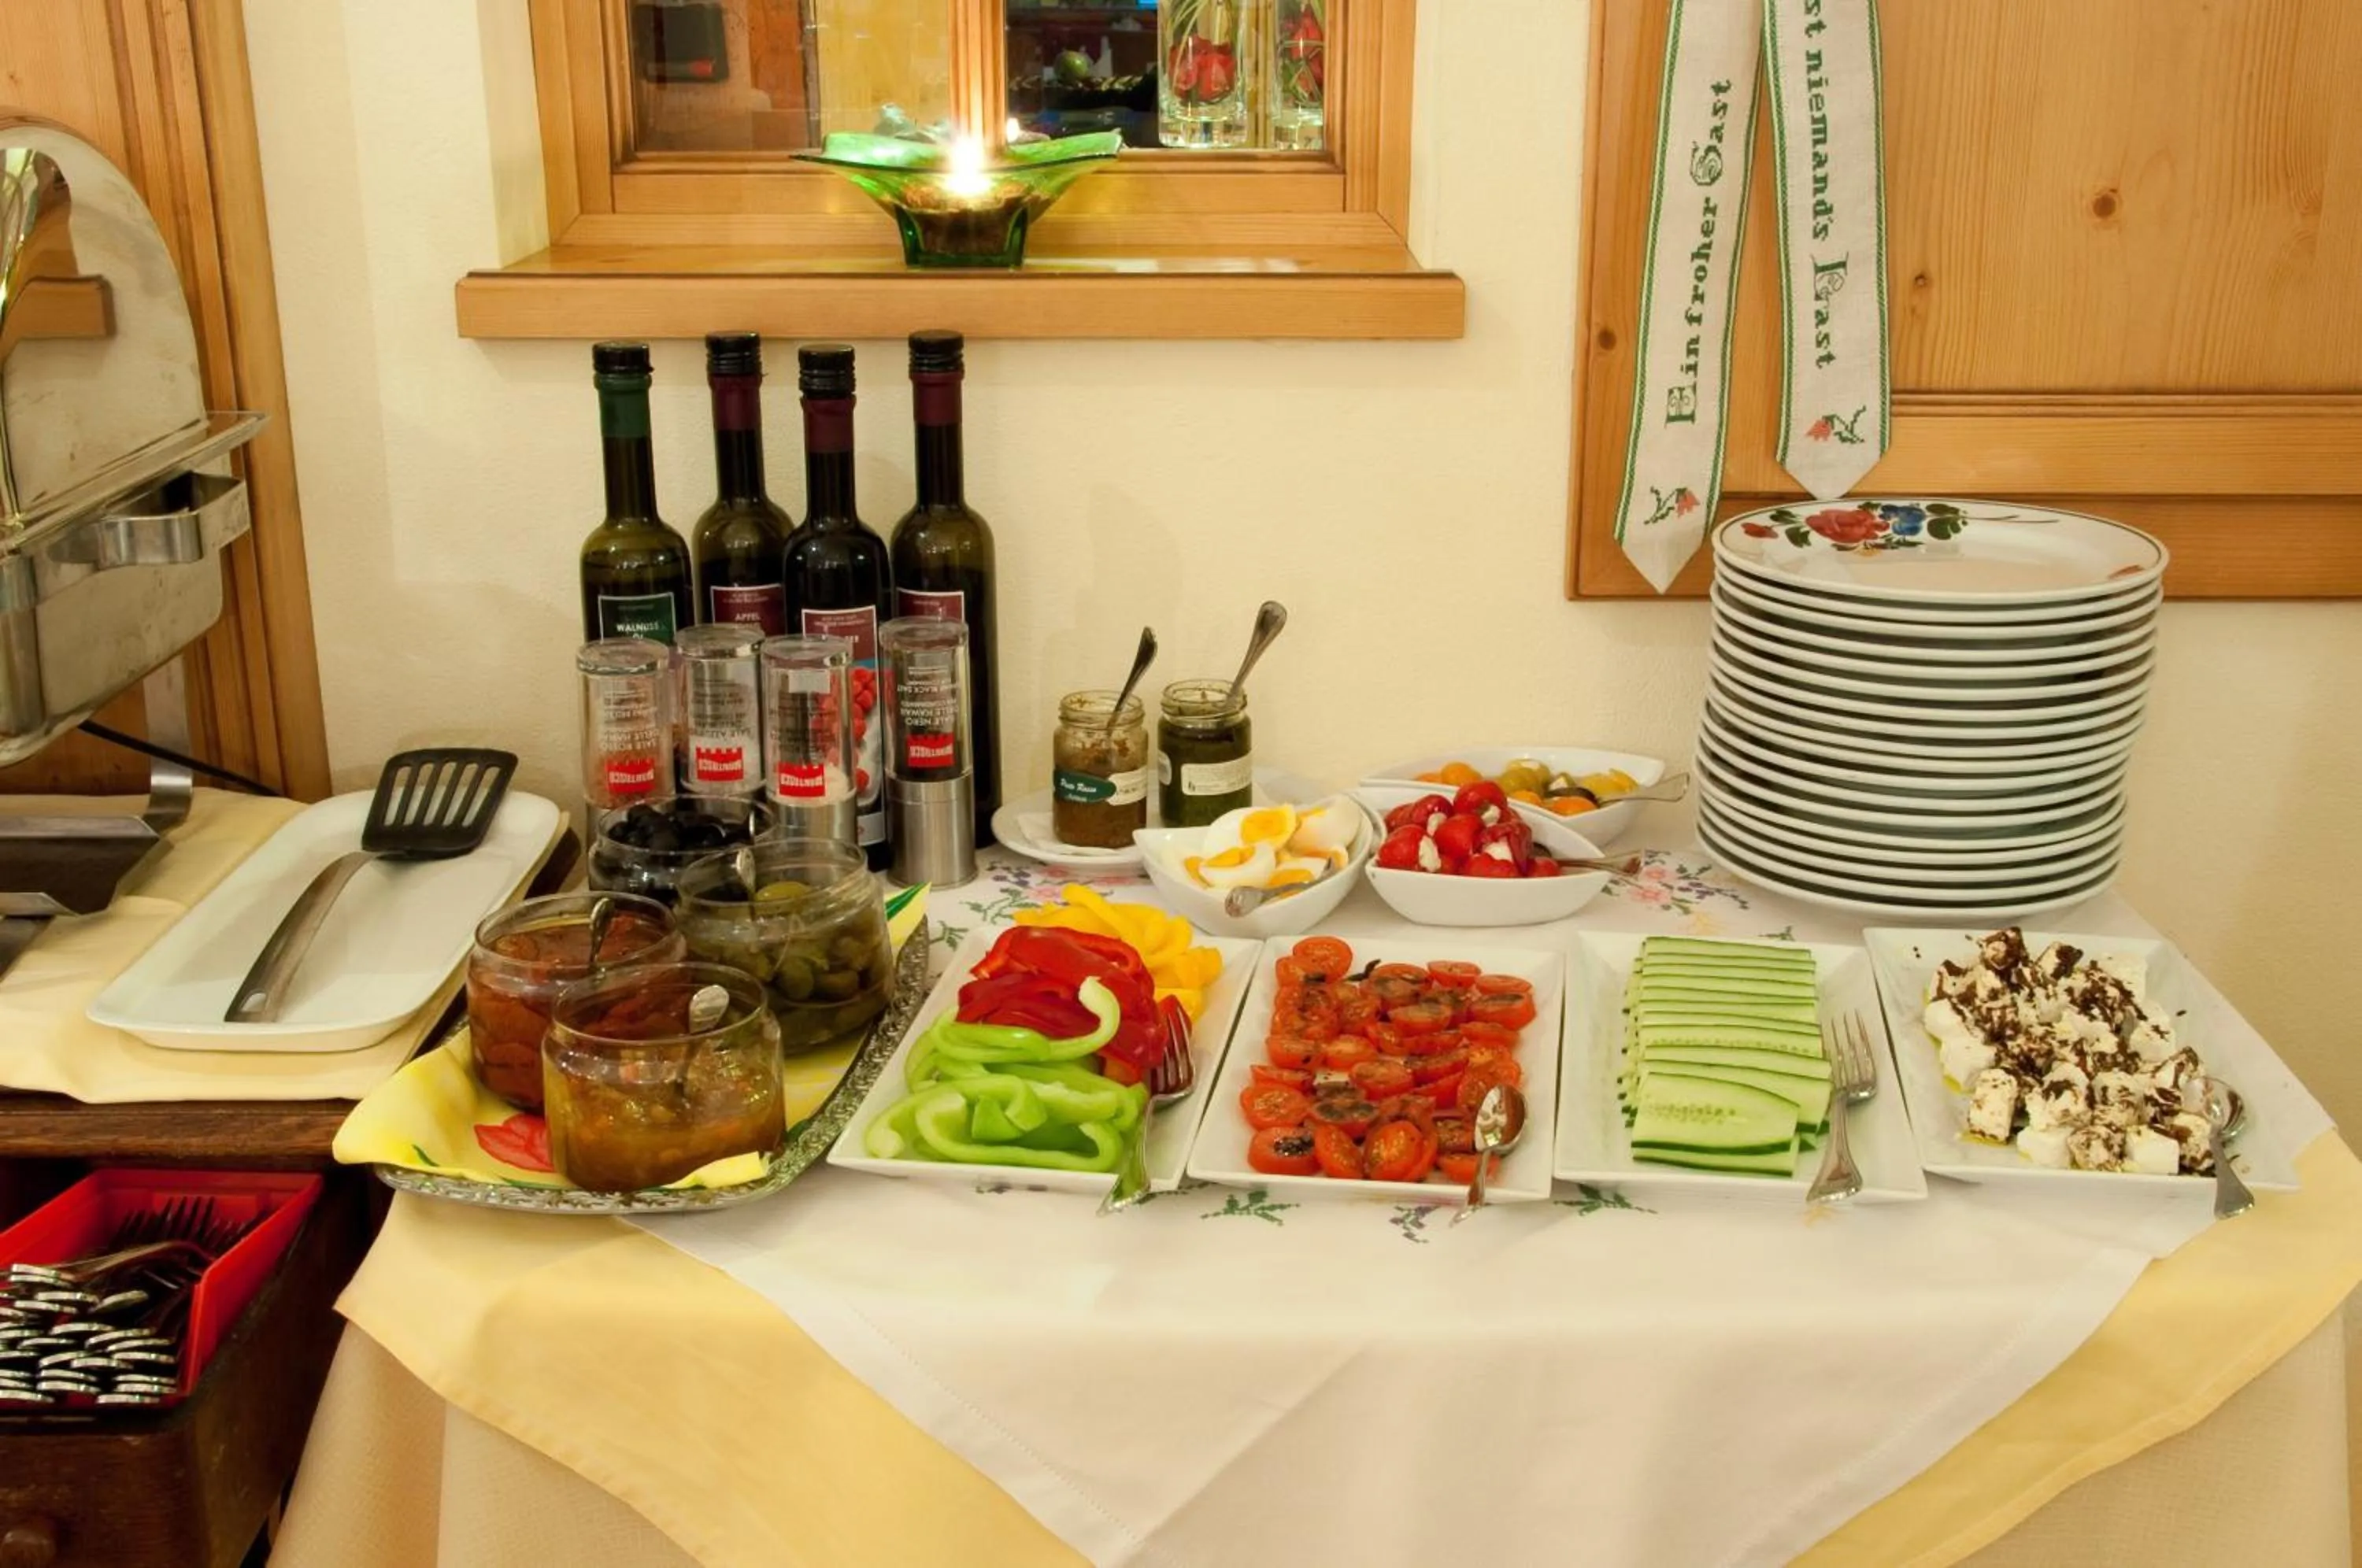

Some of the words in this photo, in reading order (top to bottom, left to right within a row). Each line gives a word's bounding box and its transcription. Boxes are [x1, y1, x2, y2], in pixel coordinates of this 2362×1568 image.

[1690, 80, 1732, 187] Gast
[1684, 196, 1718, 327] froher
[1664, 334, 1700, 429] Ein
